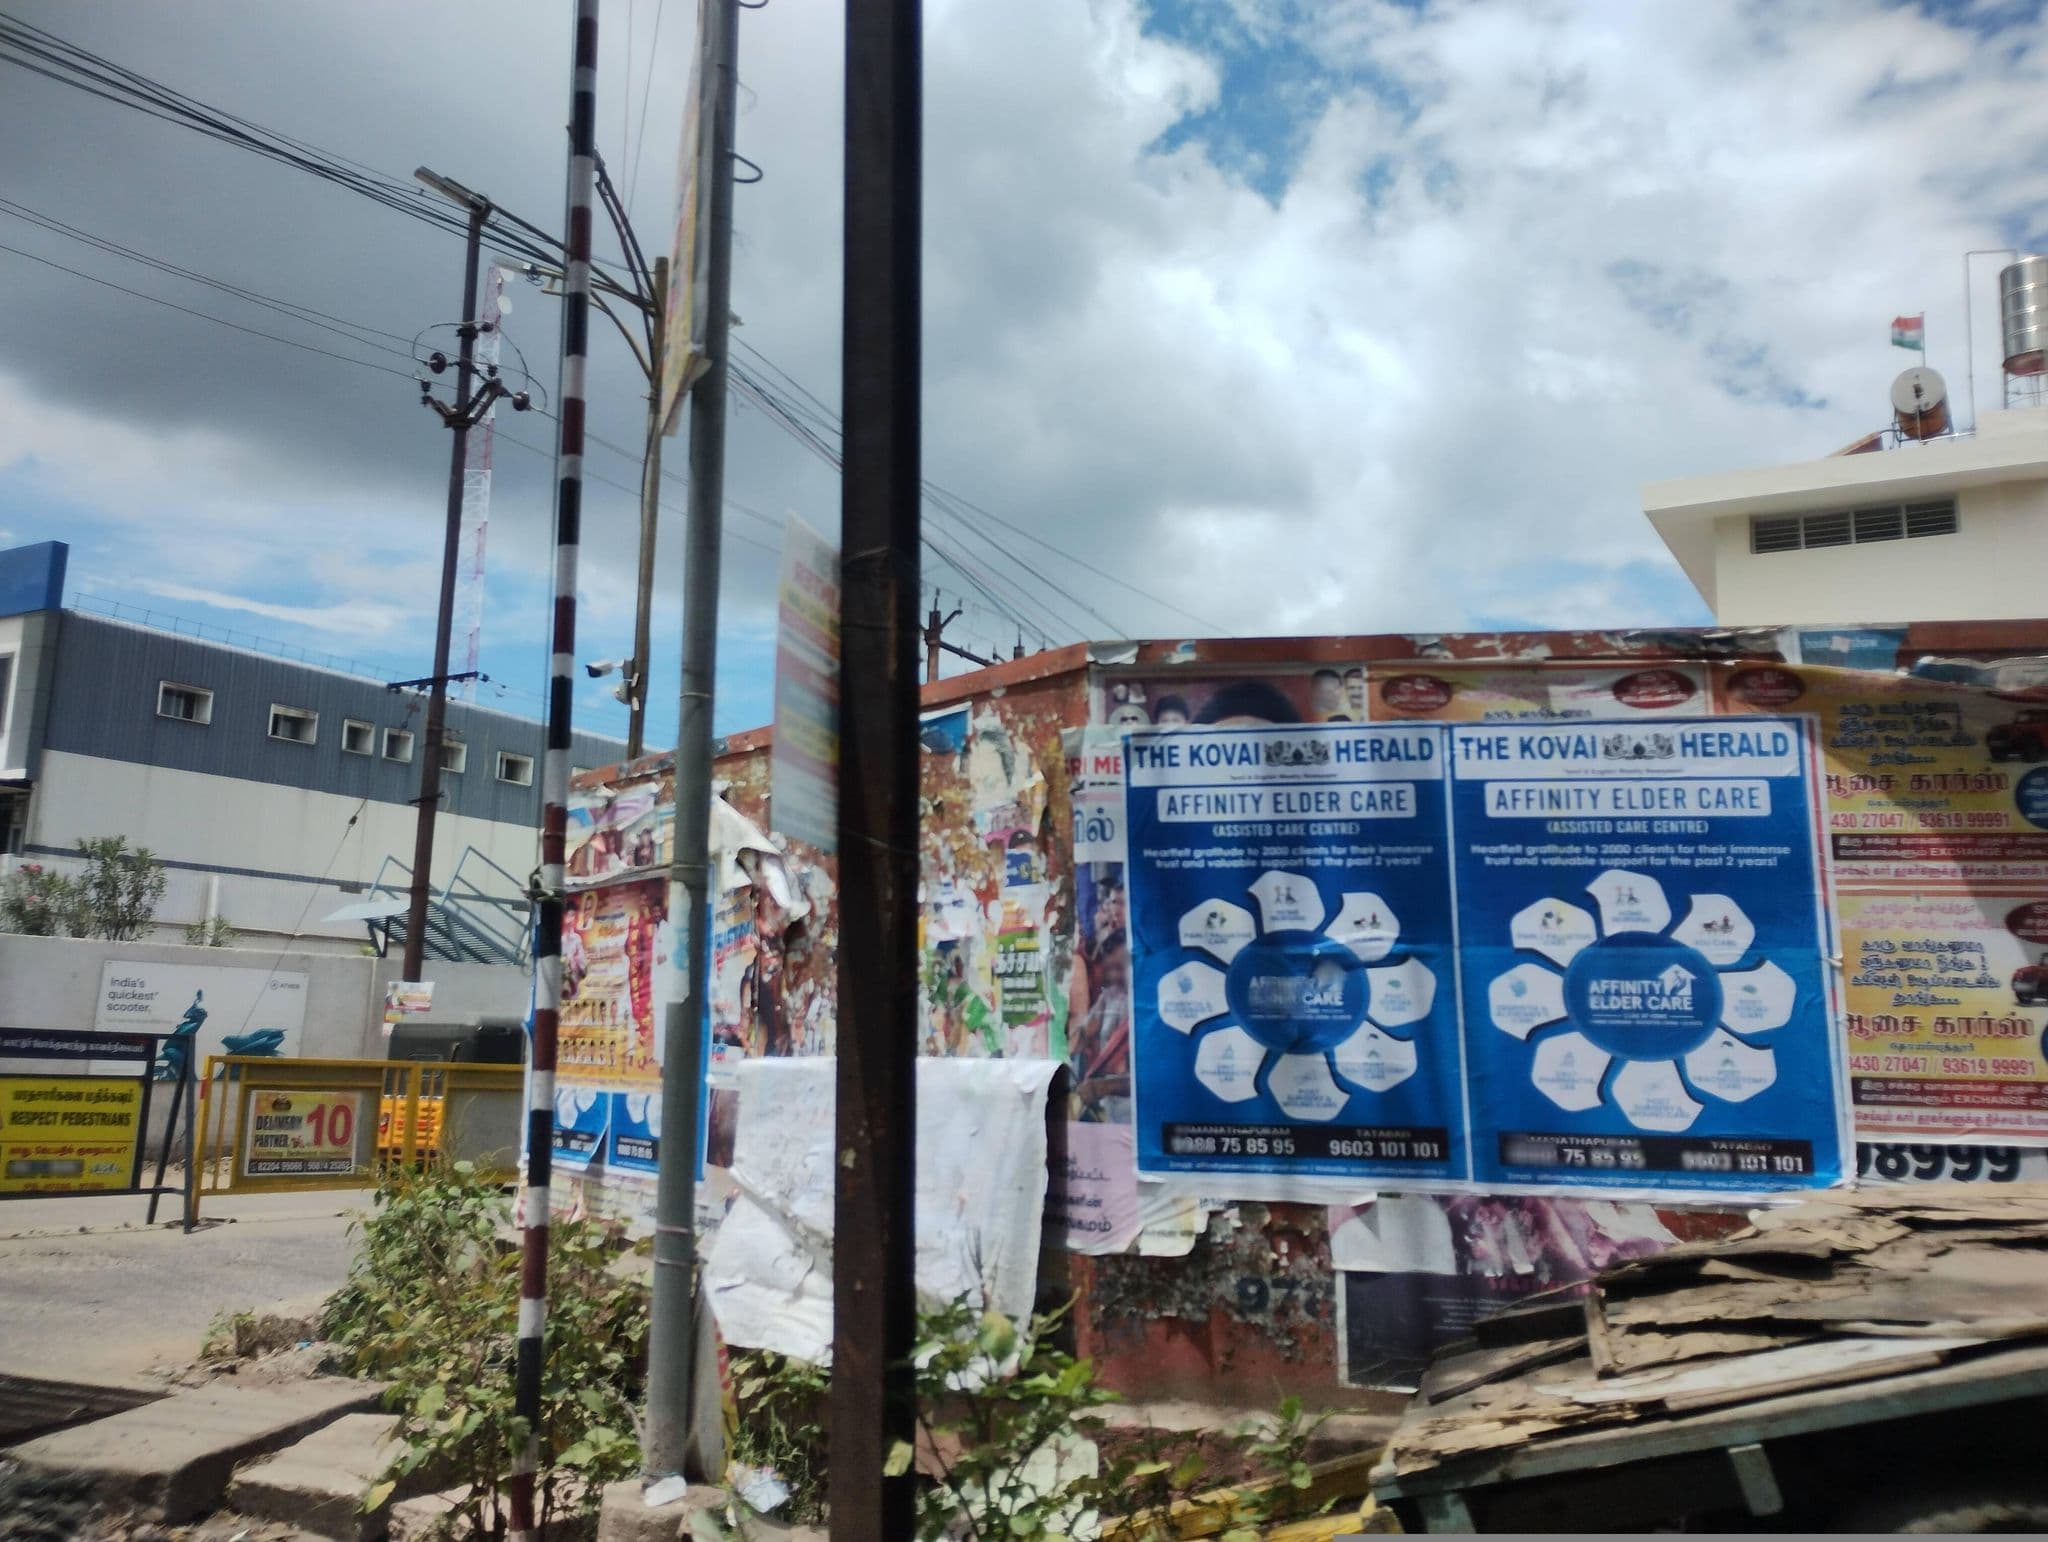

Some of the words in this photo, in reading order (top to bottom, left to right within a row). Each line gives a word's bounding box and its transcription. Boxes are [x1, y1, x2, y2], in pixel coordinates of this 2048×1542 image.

[1135, 743, 1181, 768] THE
[1189, 742, 1260, 767] KOVAI
[1335, 737, 1434, 763] HERALD
[1459, 736, 1510, 760] THE
[1520, 735, 1597, 760] KOVAI
[1680, 732, 1789, 758] HERALD
[1167, 792, 1262, 816] AFFINITY
[1273, 791, 1341, 814] ELDER
[1351, 789, 1408, 812] CARE
[1495, 787, 1601, 810] AFFINITY
[1612, 786, 1687, 810] ELDER
[1699, 786, 1761, 809] CARE
[1546, 820, 1613, 834] (ASSISTED
[1616, 820, 1649, 834] CARE
[1653, 819, 1709, 834] CENTRE)
[1862, 813, 1904, 828] 27047
[1918, 813, 1964, 829] 93619
[1526, 844, 1582, 856] gratitude
[1585, 845, 1598, 854] to
[1634, 844, 1675, 854] clients
[1678, 844, 1695, 854] for
[1698, 844, 1727, 854] their
[1730, 844, 1791, 854] immense
[1484, 856, 1511, 866] trust
[1513, 856, 1539, 866] and
[1541, 856, 1597, 866] valuable
[1600, 857, 1647, 868] support
[1650, 856, 1666, 866] for
[1670, 856, 1691, 866] the
[1694, 856, 1723, 868] past
[1726, 856, 1734, 866] 2
[110, 976, 145, 989] India's
[1589, 979, 1662, 995] AFFINITY
[1302, 991, 1345, 1007] CARE
[1589, 995, 1643, 1011] ELDER
[1647, 995, 1694, 1011] CARE
[1885, 1056, 1928, 1073] 27047
[1943, 1057, 1988, 1075] 93619
[1991, 1058, 2037, 1076] 99991
[1953, 1095, 2028, 1106] EXCHANGE
[9, 1111, 60, 1126] RESPECT
[61, 1112, 132, 1126] PEDESTRIANS
[255, 1114, 303, 1131] DELIVERY
[306, 1103, 353, 1147] 10
[1220, 1137, 1241, 1154] 75
[1246, 1137, 1269, 1154] 85
[1272, 1138, 1295, 1155] 95
[1329, 1139, 1374, 1156] 9603
[1379, 1141, 1406, 1157] 101
[1412, 1142, 1439, 1158] 101
[1562, 1148, 1586, 1165] 75
[1773, 1155, 1804, 1172] 101
